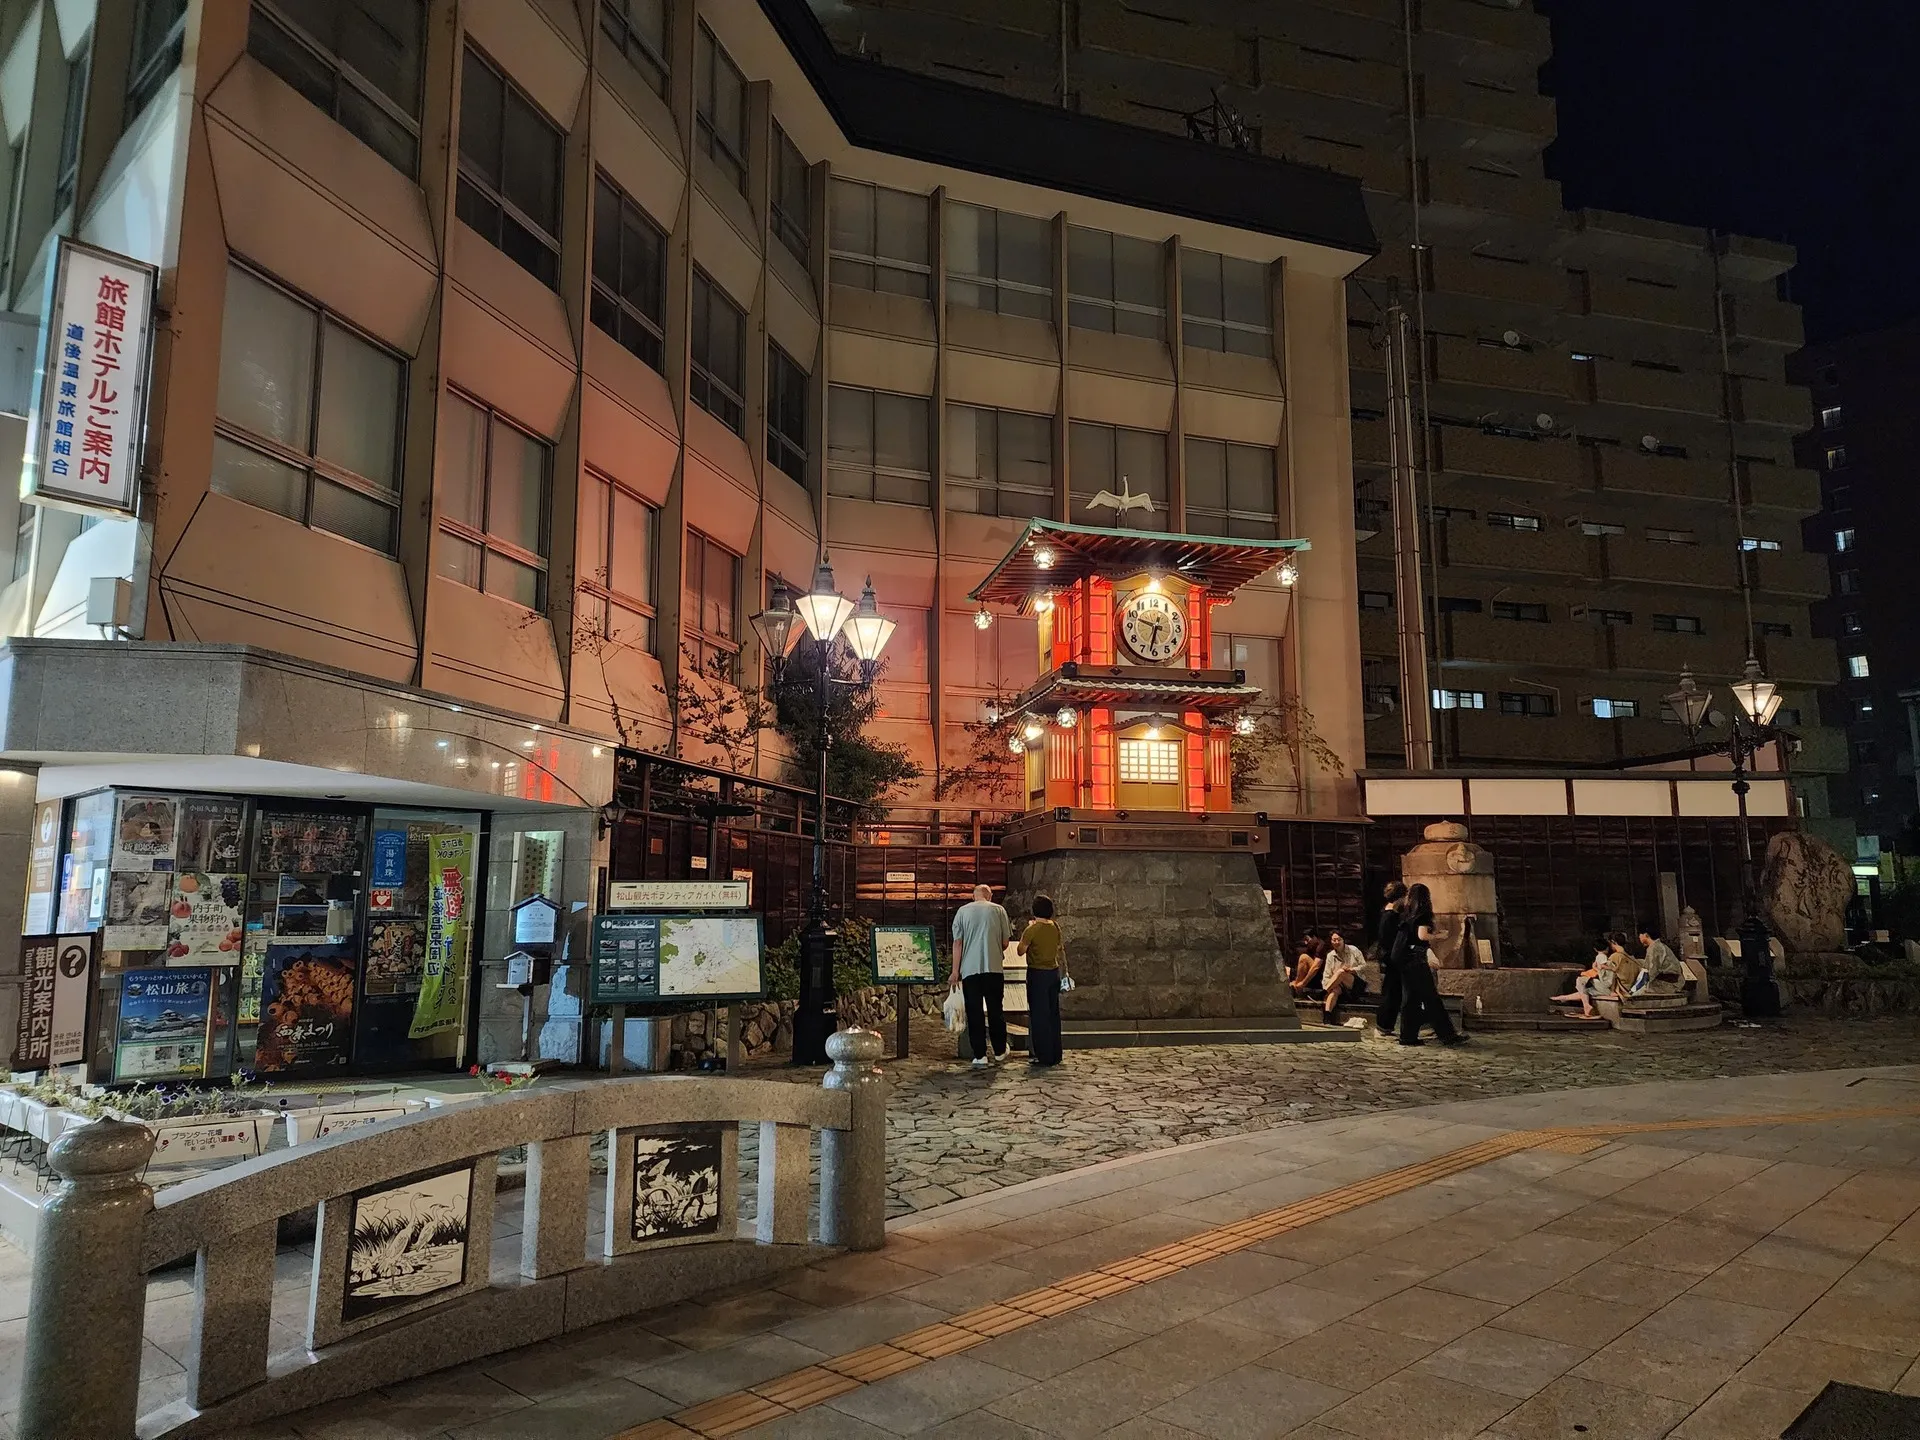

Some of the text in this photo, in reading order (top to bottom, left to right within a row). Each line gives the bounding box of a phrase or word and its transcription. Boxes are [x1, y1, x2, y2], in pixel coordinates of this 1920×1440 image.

[79, 275, 130, 485] 旅館ホテルご案内
[52, 322, 85, 476] 道後温泉旅館組合
[1136, 601, 1145, 611] 11
[1150, 598, 1159, 608] 12
[1164, 603, 1168, 612] 1
[1128, 610, 1138, 618] 10
[1172, 612, 1179, 620] 2
[1127, 623, 1133, 631] 9
[1175, 625, 1181, 633] 3
[1131, 634, 1137, 643] 8
[1140, 645, 1146, 653] 7
[1152, 648, 1158, 656] 6
[616, 890, 742, 901] 松山観光ボランティアガイド(無料)
[192, 903, 223, 914] 内子町
[189, 914, 228, 924] 果物狩り
[145, 982, 189, 996] 松山旅
[19, 948, 34, 1061] Tourist Information Center
[29, 946, 56, 1060] 観光案内所
[172, 1128, 223, 1140] プランター花壇
[184, 1134, 235, 1147] 花いっぱい運動
